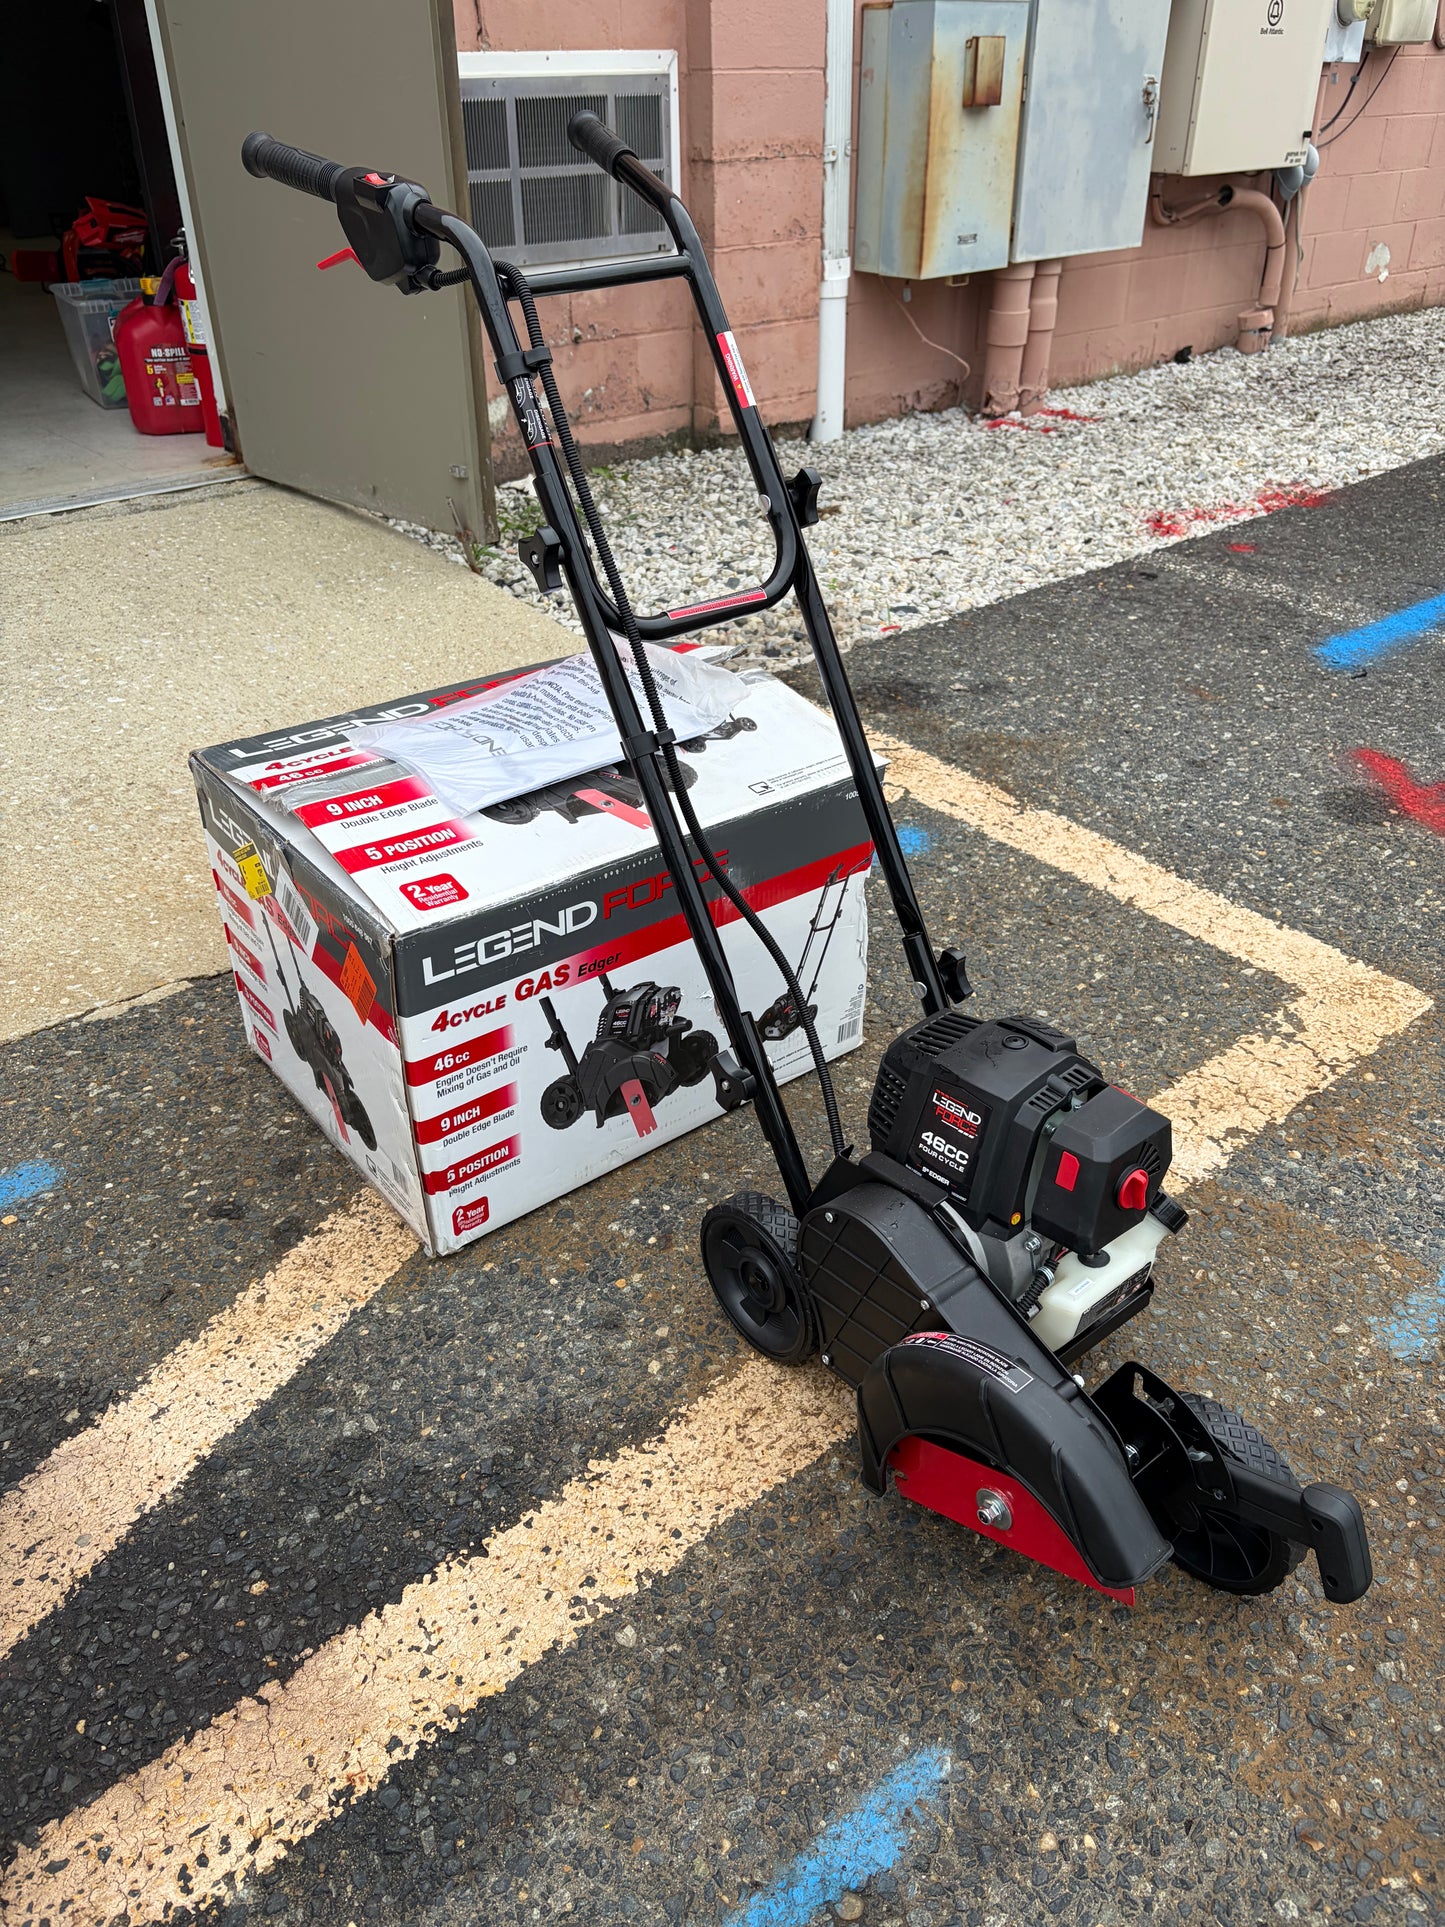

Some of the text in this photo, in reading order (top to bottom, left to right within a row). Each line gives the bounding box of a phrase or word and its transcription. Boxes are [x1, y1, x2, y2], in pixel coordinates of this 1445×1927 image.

[151, 347, 186, 358] NO-SPILL
[725, 353, 739, 382] WARNING
[146, 364, 154, 375] 5
[524, 377, 534, 399] ENGAGE
[534, 409, 547, 440] DISENGAGE
[228, 703, 430, 760] LEGEND
[519, 734, 535, 749] usar
[264, 746, 354, 771] 4CYCLE
[325, 794, 384, 816] 9 INCH
[340, 796, 439, 830] Double Edge Blade
[363, 828, 457, 861] 5 POSITION
[379, 839, 485, 876] Height Adjustments
[407, 880, 454, 899] 2 Year
[417, 888, 458, 904] Residential
[424, 894, 460, 909] Warranty
[422, 900, 598, 986] LEGEND
[431, 951, 623, 1033] 4CYCLE GAS Edger
[435, 1045, 528, 1090] Engine Doesn't Require
[436, 1056, 520, 1099] Mixing of Gas and Oil
[440, 1105, 481, 1132] 9 INCH
[932, 1091, 982, 1127] LEGEND
[935, 1104, 978, 1137] FORCE
[442, 1108, 515, 1148] Double Edge Blade
[458, 1145, 510, 1178] POSITION
[918, 1142, 939, 1159] FOUR
[938, 1153, 965, 1174] CYCLE
[920, 1130, 970, 1166] 46CC
[474, 1157, 522, 1187] Adjustments
[928, 1168, 951, 1187] EDGER
[455, 1203, 486, 1223] 2 Year
[994, 1357, 1009, 1369] BLADE
[996, 1369, 1018, 1388] GIRATORIA
